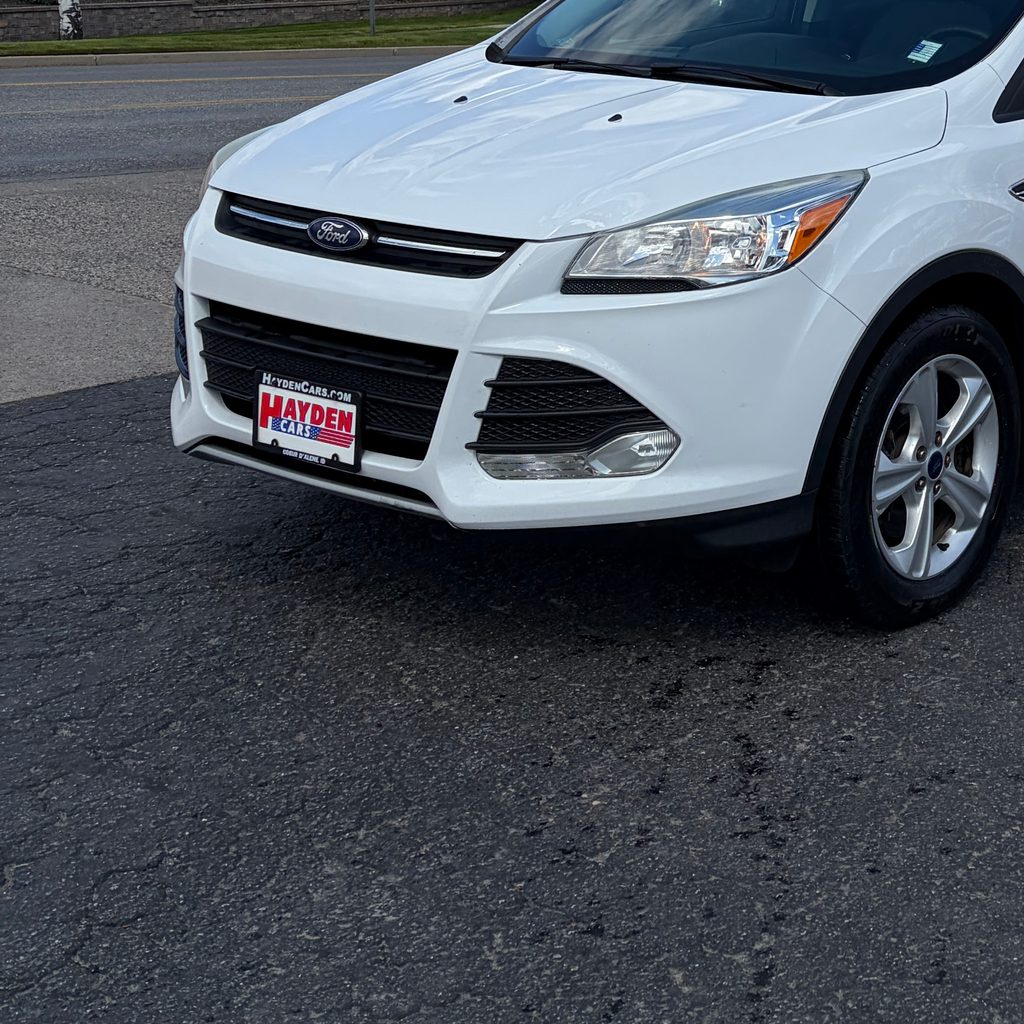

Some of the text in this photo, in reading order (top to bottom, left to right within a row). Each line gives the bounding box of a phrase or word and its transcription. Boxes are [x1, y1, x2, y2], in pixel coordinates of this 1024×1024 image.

[317, 221, 351, 244] Ford
[259, 392, 354, 434] HAYDEN
[280, 420, 311, 437] CARS
